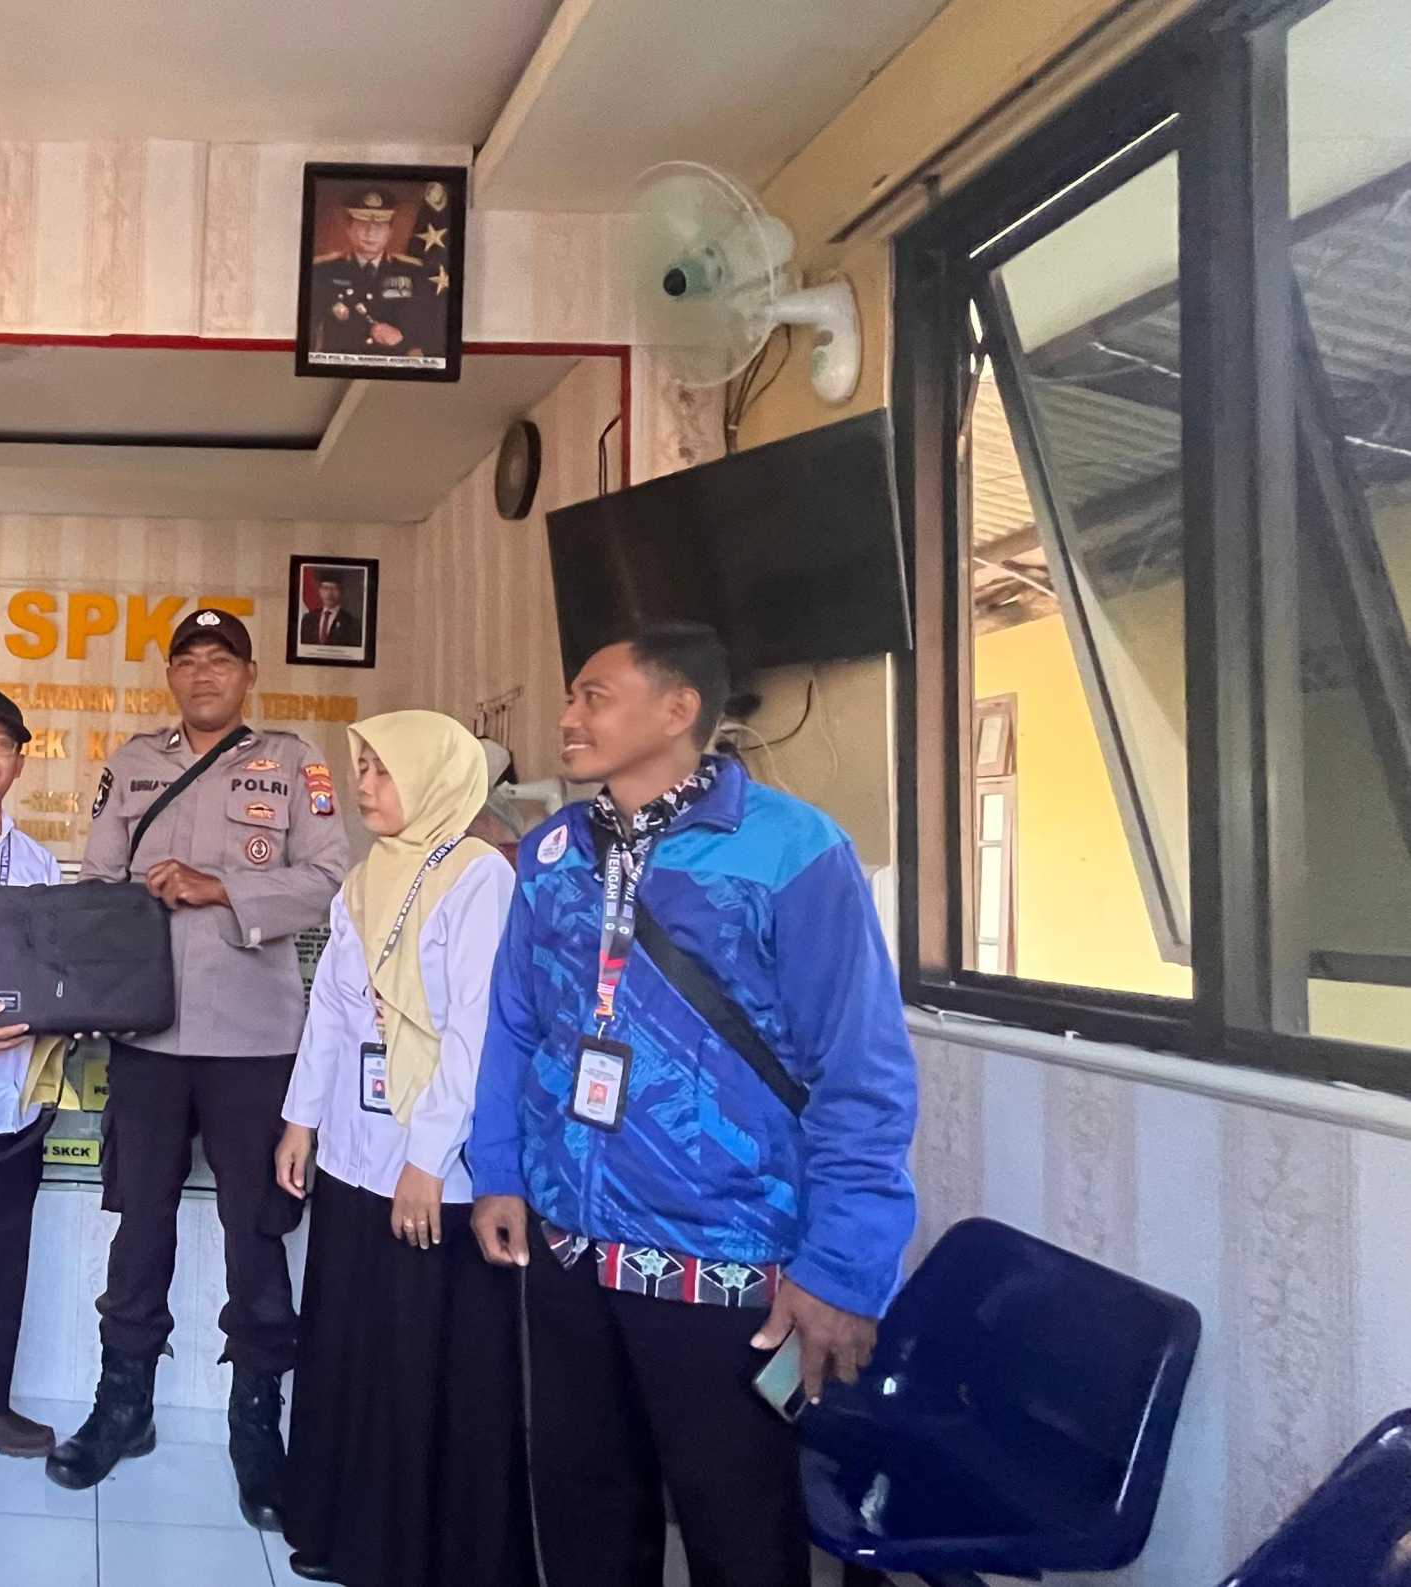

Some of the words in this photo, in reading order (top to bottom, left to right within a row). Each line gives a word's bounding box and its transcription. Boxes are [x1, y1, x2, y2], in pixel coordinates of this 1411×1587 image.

[231, 778, 289, 796] POLRI
[624, 882, 636, 902] TIM
[52, 1145, 91, 1158] SKCK
